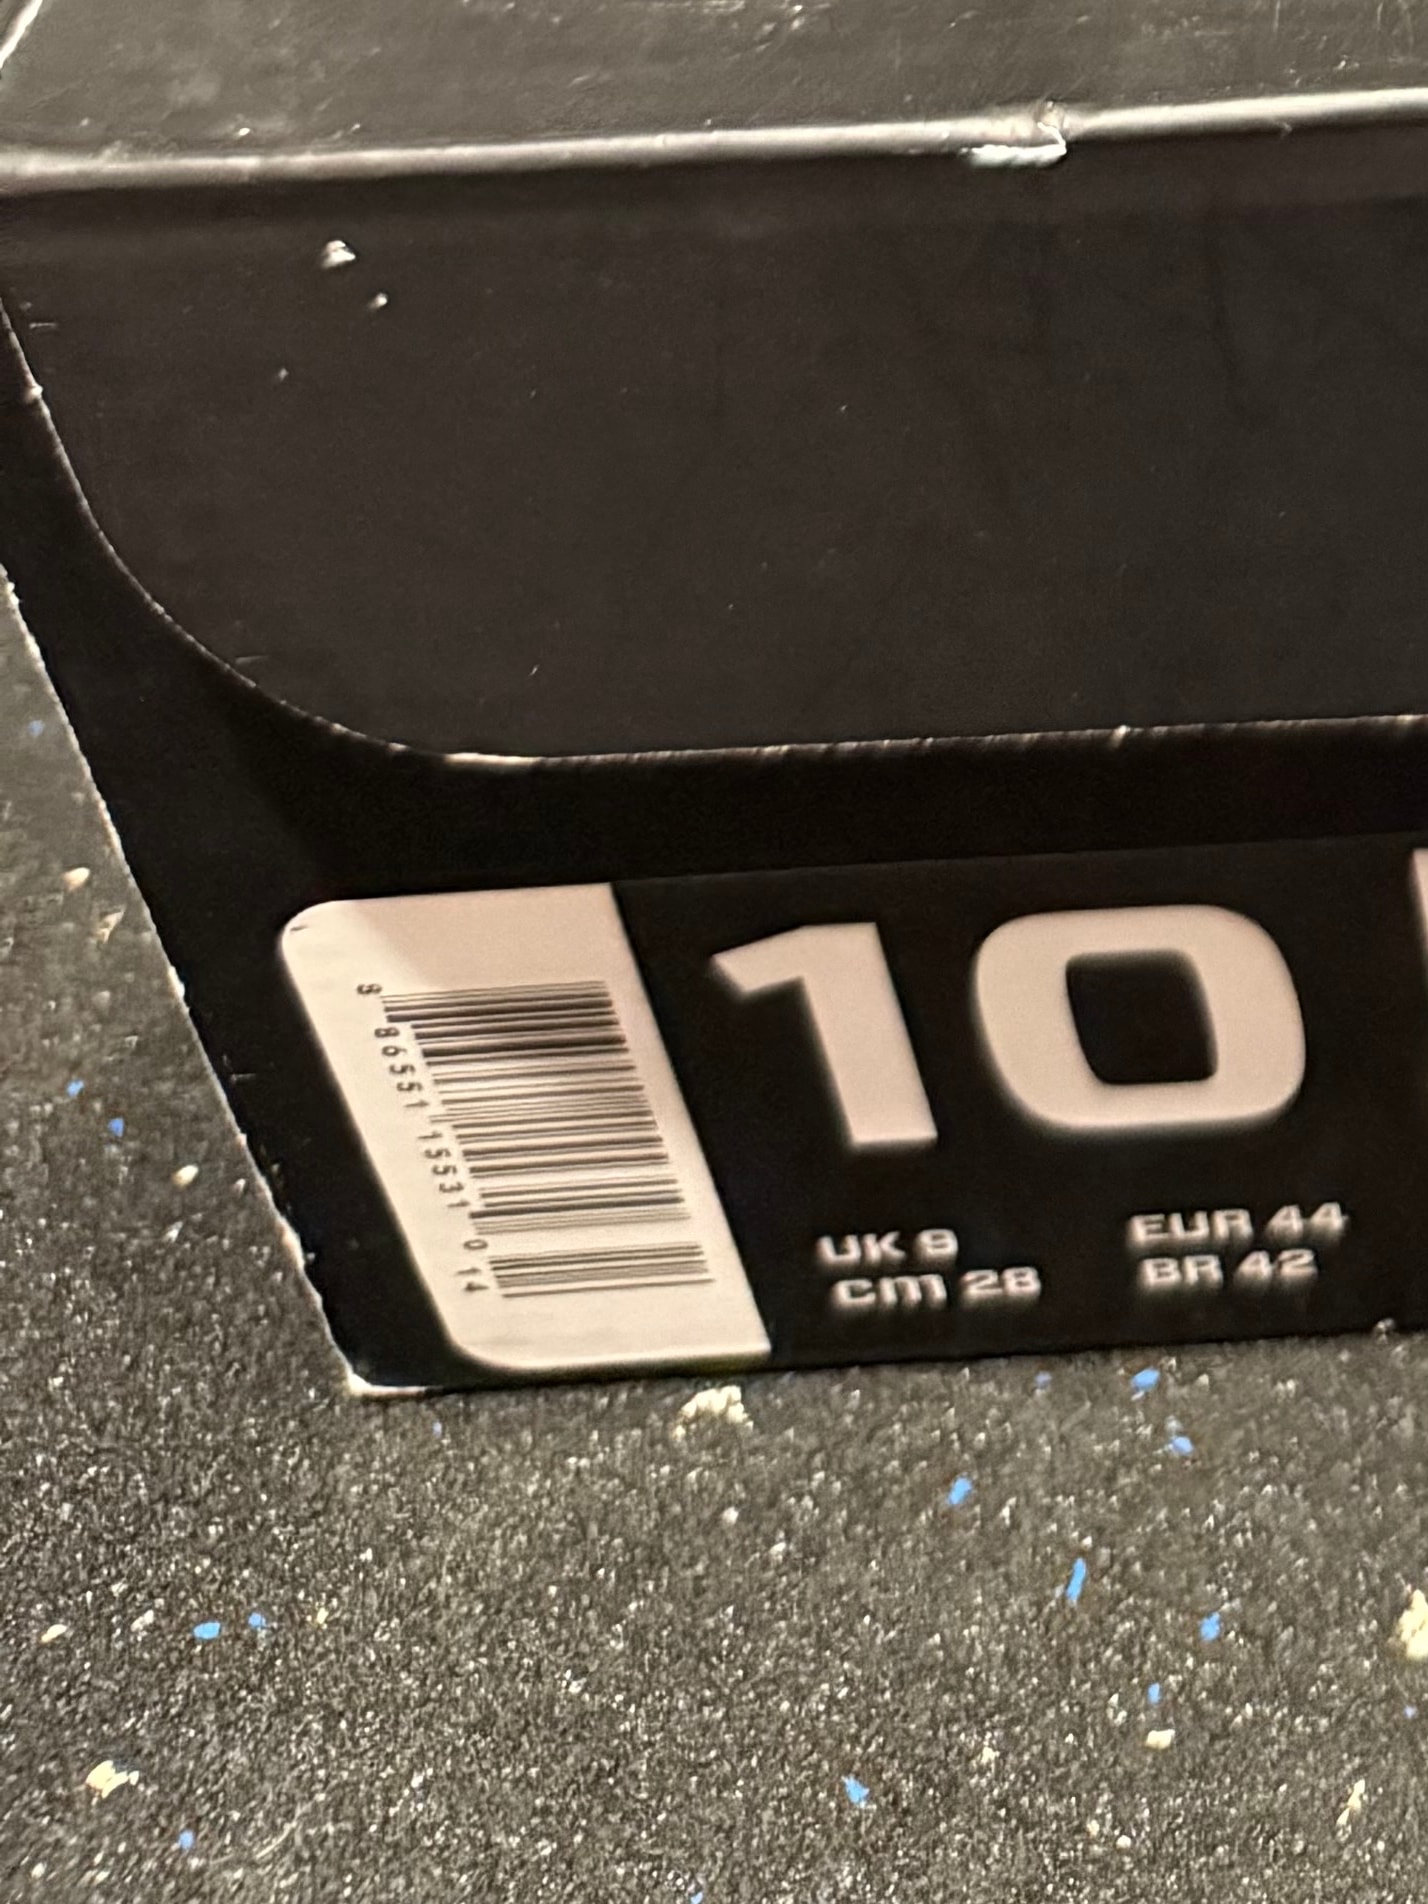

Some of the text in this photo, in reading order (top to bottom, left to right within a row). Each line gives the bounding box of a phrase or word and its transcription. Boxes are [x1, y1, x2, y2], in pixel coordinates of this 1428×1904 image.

[711, 903, 1309, 1154] 10
[1130, 1201, 1349, 1246] EUR 44
[817, 1232, 907, 1265] UK
[1138, 1247, 1318, 1288] BR 42
[960, 1266, 1041, 1300] 28
